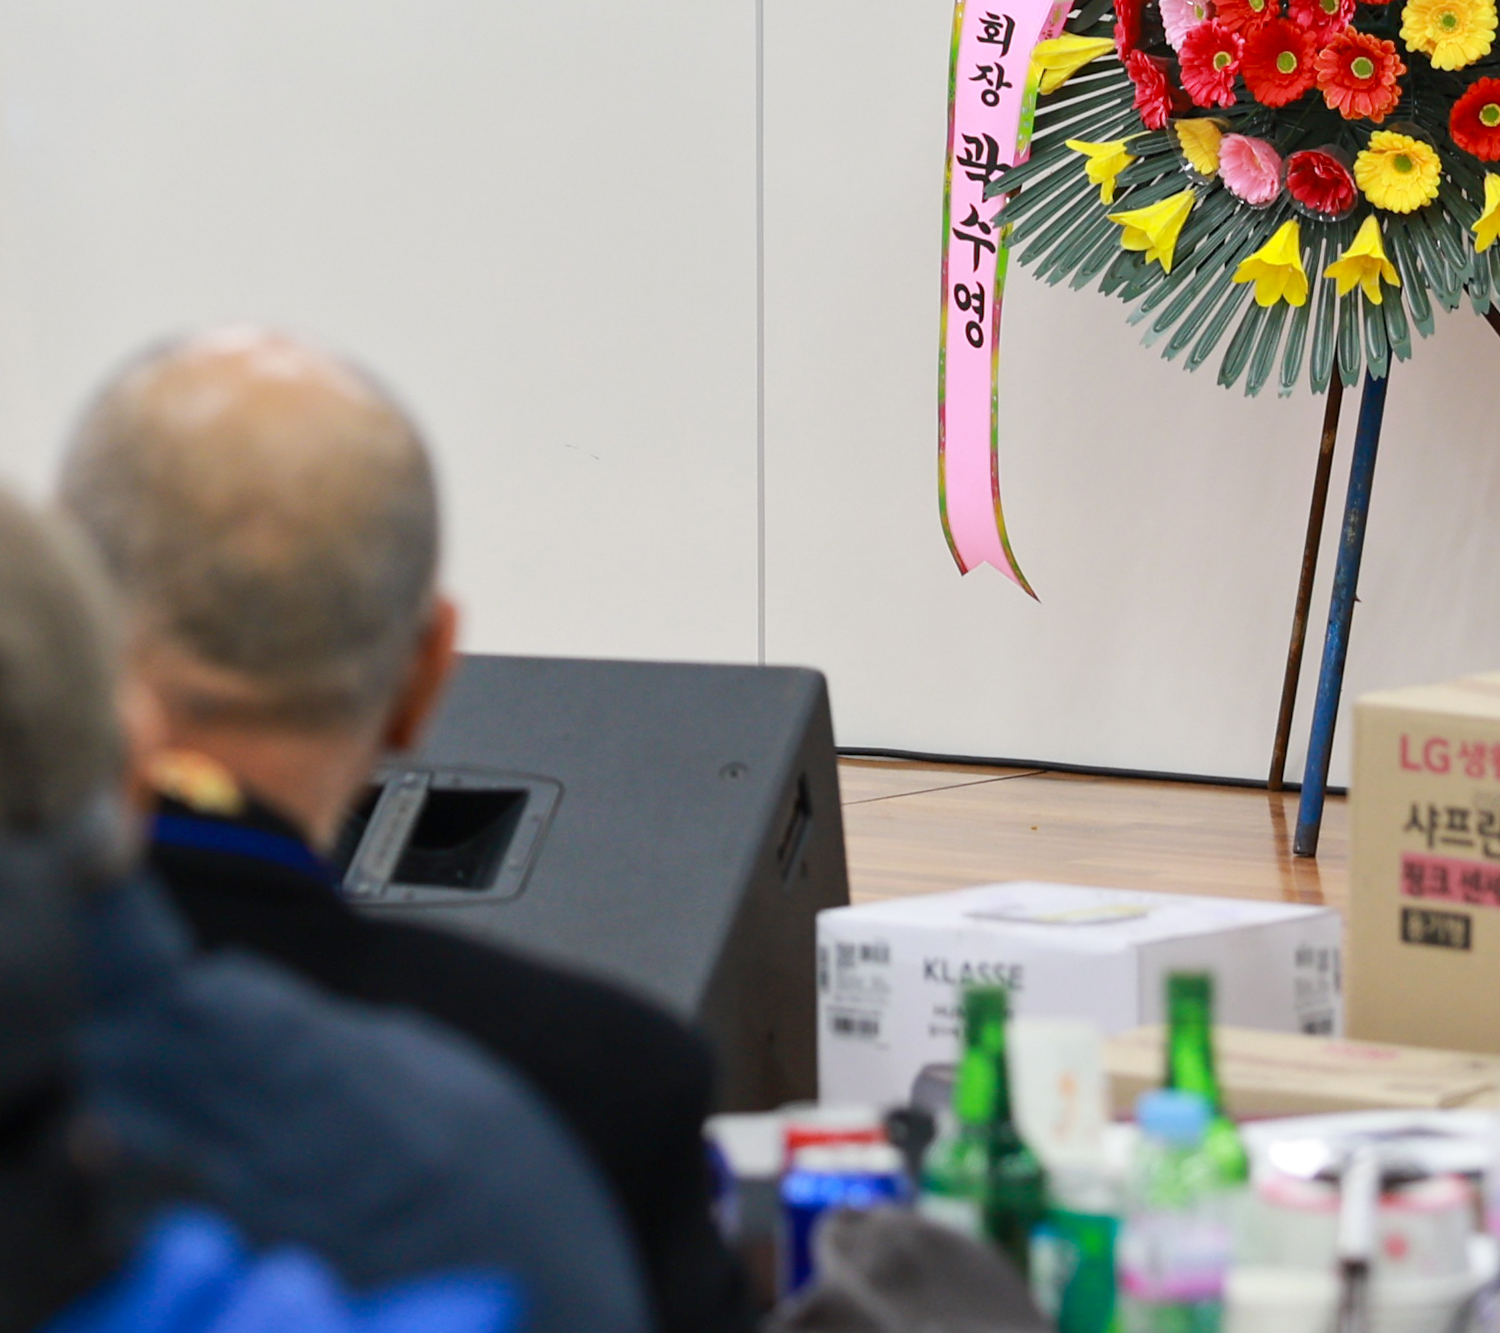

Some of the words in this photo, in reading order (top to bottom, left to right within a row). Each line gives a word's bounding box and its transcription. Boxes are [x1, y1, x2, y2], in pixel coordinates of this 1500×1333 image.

[967, 11, 1017, 109] 회장
[952, 132, 1014, 351] 곽수영
[1400, 734, 1452, 775] LG
